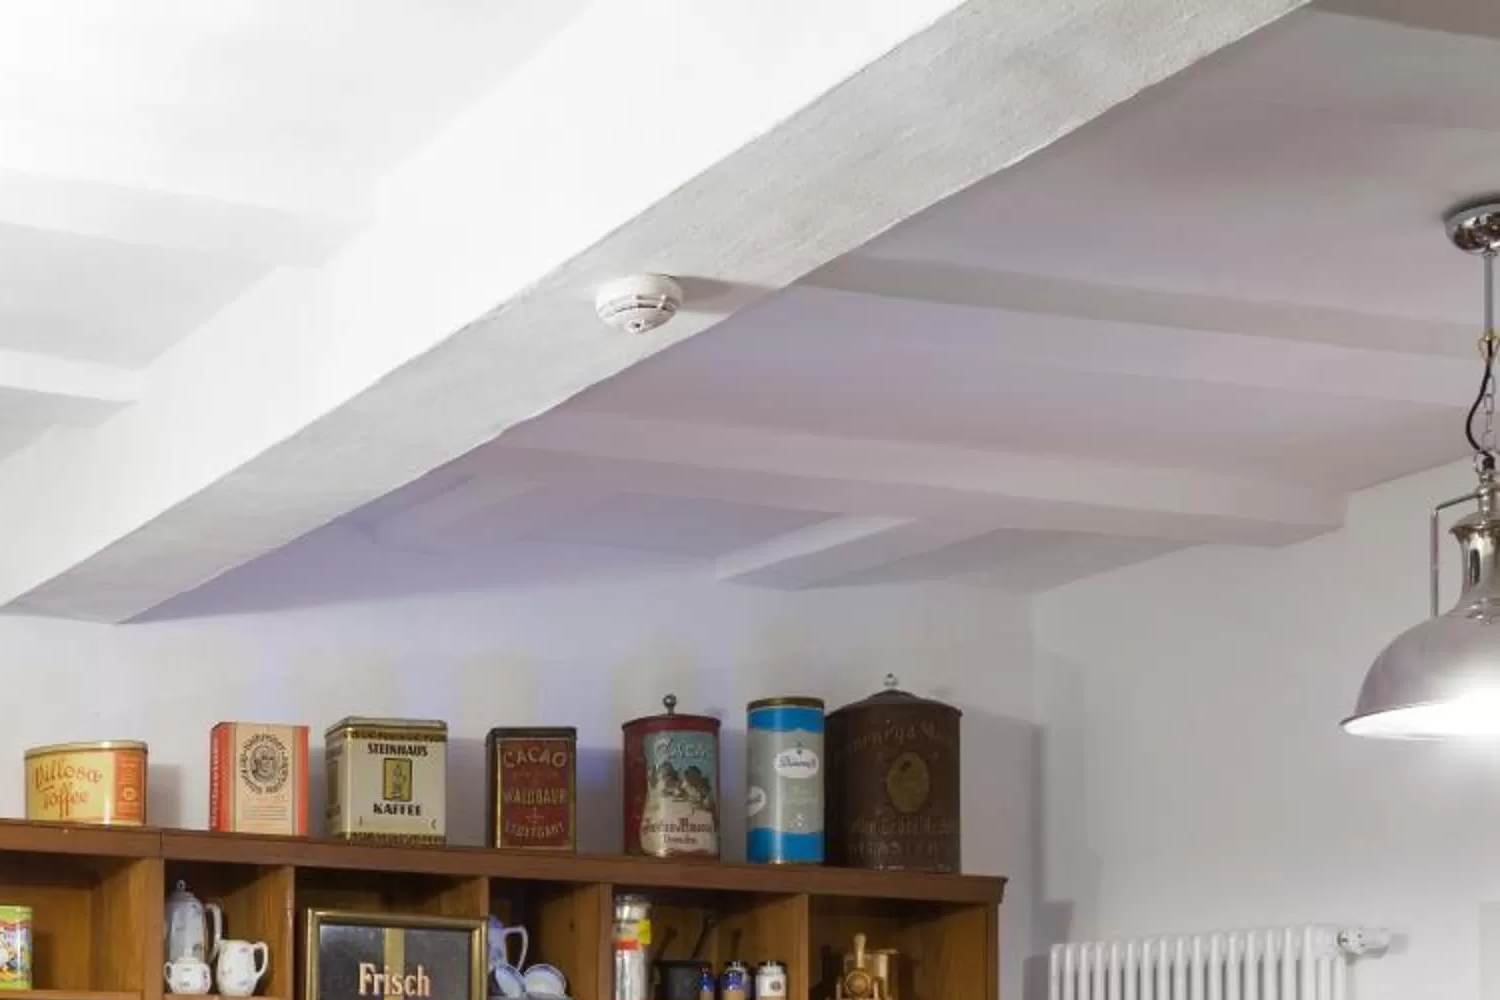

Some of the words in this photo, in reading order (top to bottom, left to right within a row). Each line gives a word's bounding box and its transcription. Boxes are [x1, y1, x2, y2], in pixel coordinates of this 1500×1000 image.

[367, 743, 428, 756] STEINHAUS
[503, 746, 567, 768] CACAO
[373, 803, 421, 815] KAFFEE
[358, 962, 431, 997] Frisch
